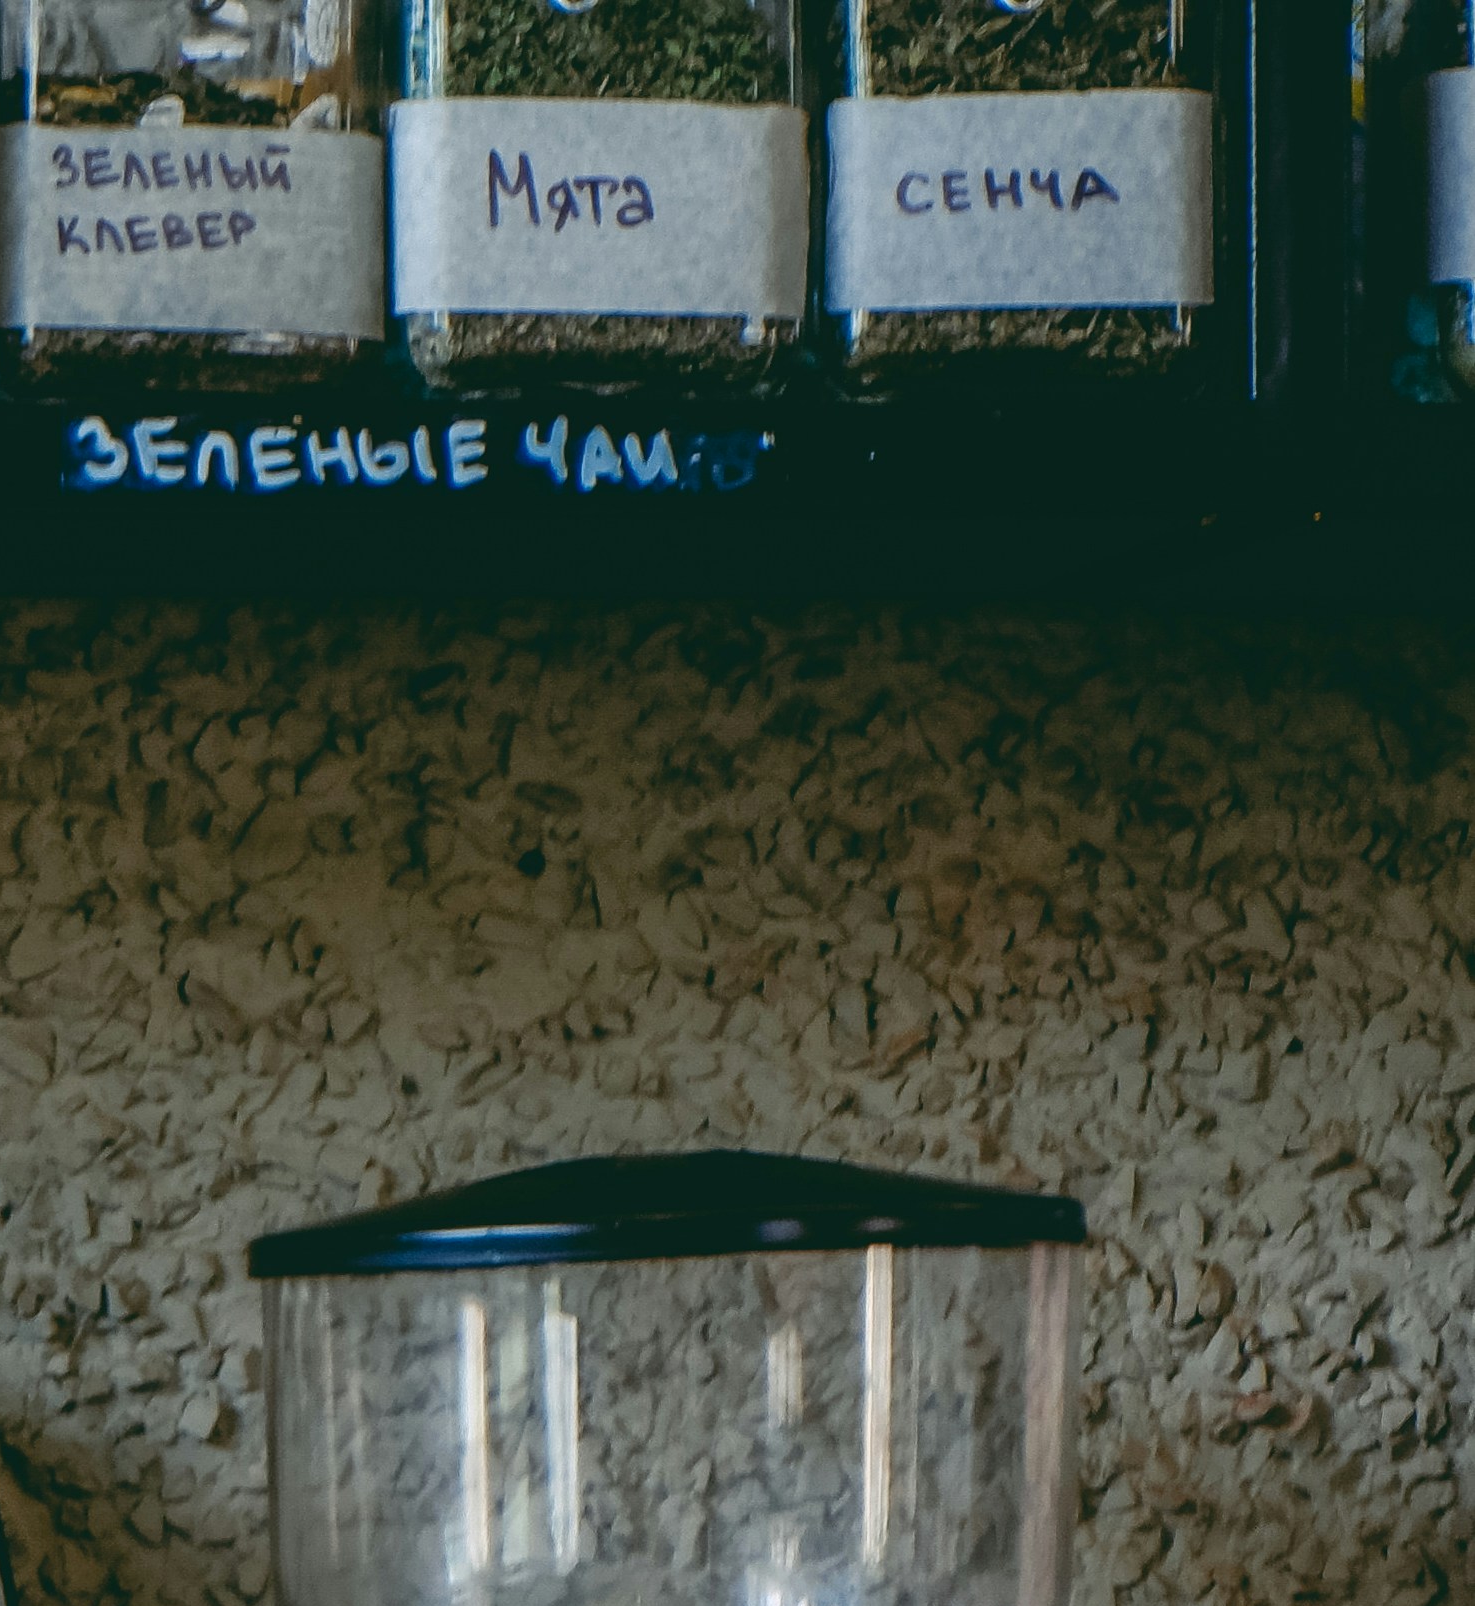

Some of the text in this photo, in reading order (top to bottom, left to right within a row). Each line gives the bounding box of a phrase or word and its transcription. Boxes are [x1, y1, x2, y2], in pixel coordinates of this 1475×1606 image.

[51, 143, 293, 193] ЗЕЛЕНЫЙ
[487, 147, 655, 234] Мята
[894, 166, 1121, 212] СЕНЧА
[56, 209, 257, 256] КЛЕВЕР
[73, 414, 491, 489] ЗЕЛЕНЫЕ
